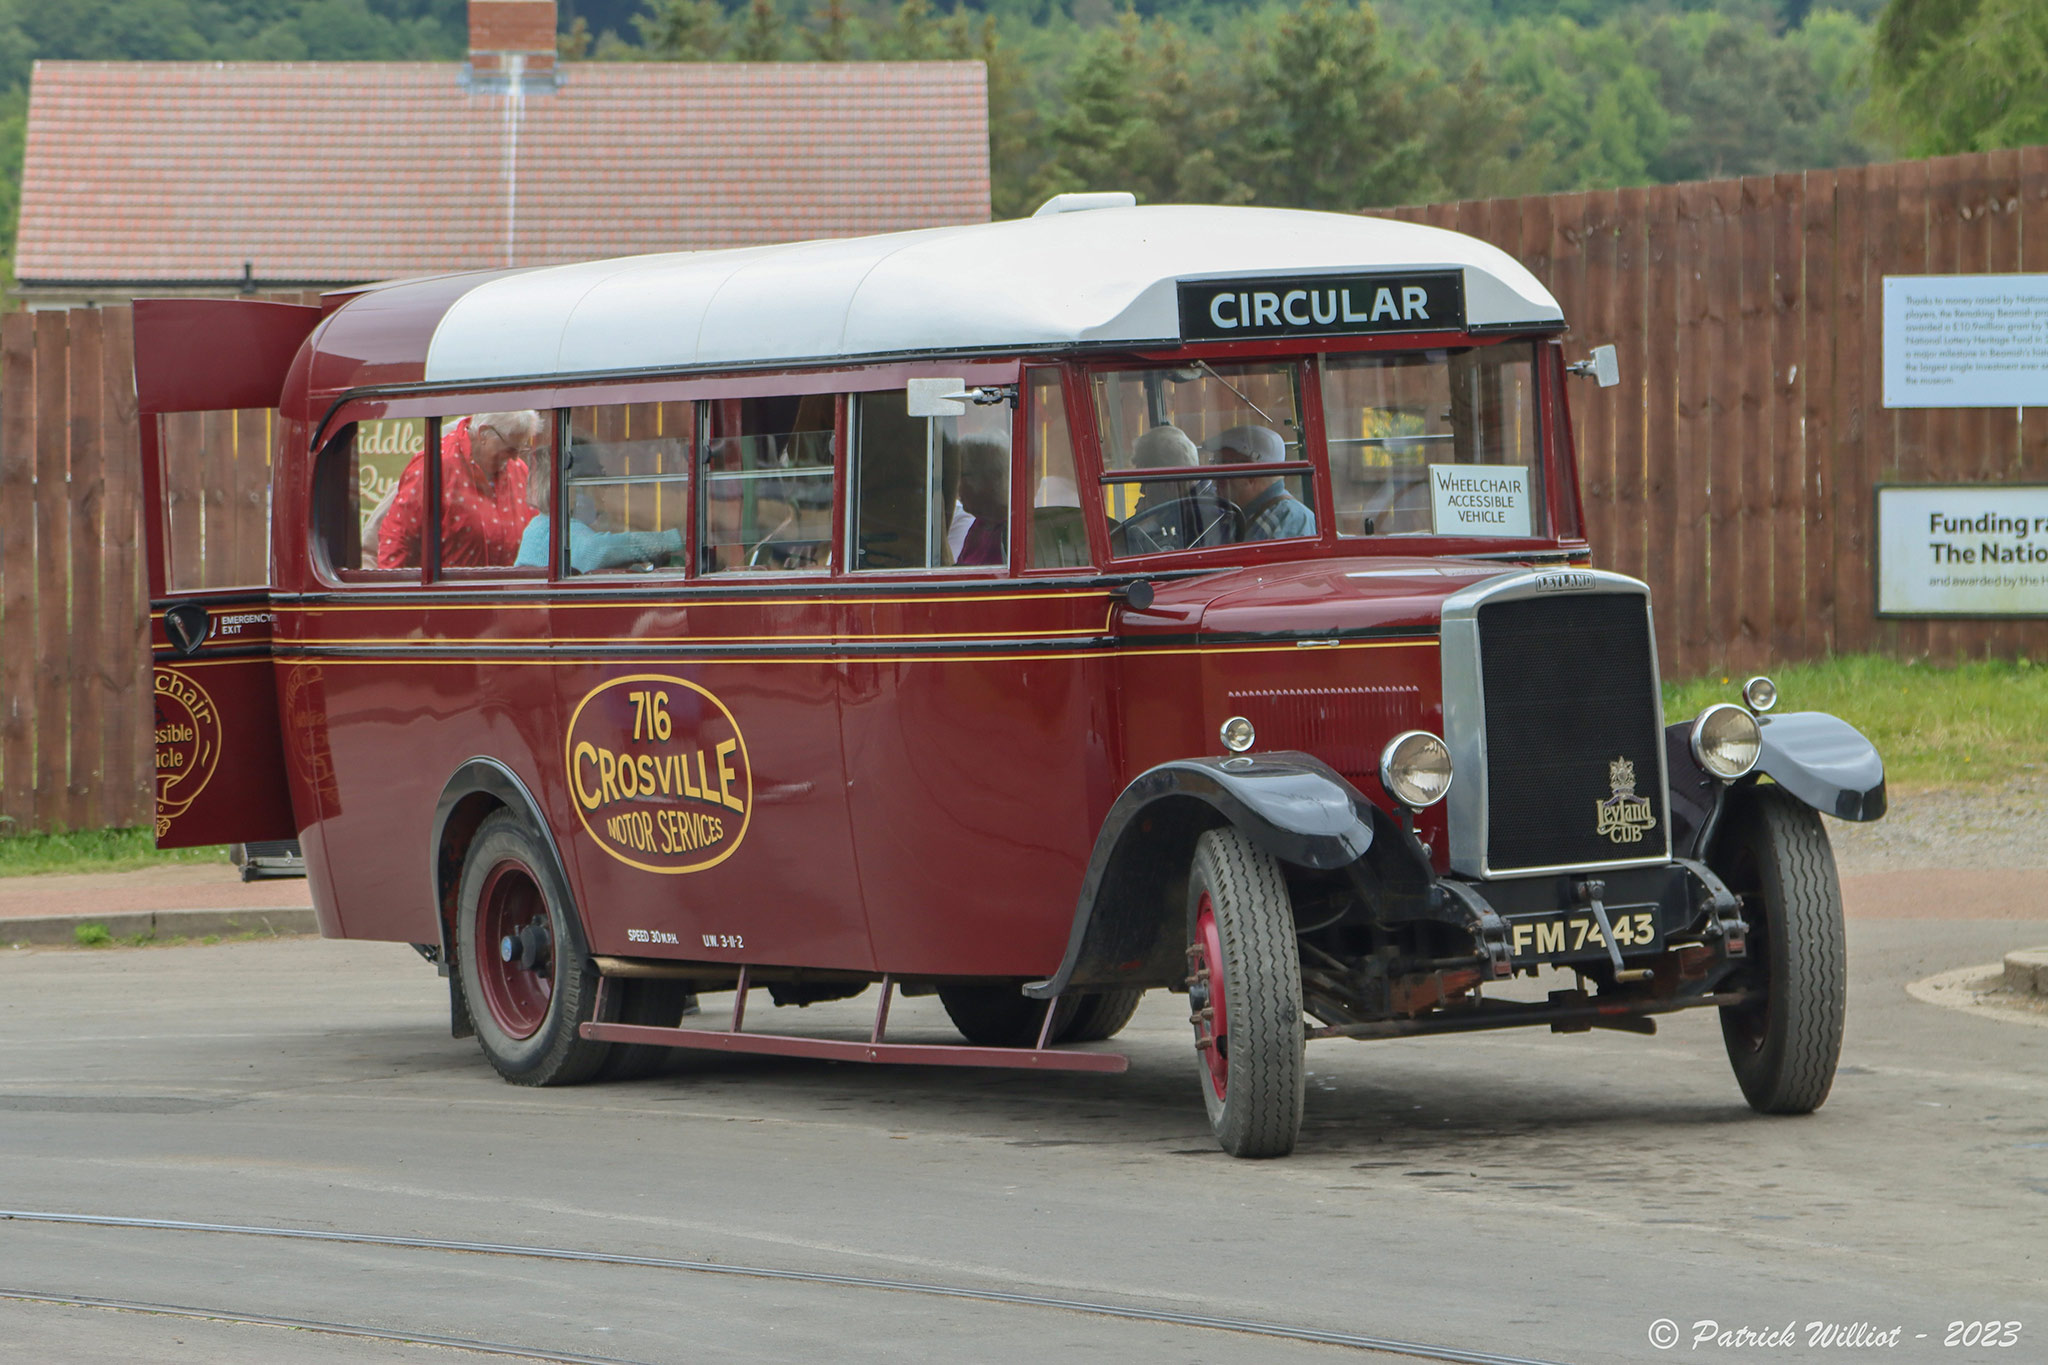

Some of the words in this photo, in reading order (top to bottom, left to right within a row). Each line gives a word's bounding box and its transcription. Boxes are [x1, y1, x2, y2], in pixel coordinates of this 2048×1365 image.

[1210, 286, 1430, 329] CIRCULAR
[1906, 296, 1932, 304] Thanks
[1945, 298, 1973, 306] money
[2004, 296, 2013, 305] by
[1998, 308, 2032, 317] Beamish
[1906, 323, 1942, 331] awarded
[2008, 324, 2029, 333] grant
[2032, 322, 2042, 332] by
[1906, 336, 1940, 345] National
[1945, 337, 1971, 346] Lottery
[1975, 336, 2009, 346] Heritage
[2013, 335, 2032, 344] Fund
[1906, 363, 1916, 371] the
[1920, 362, 1947, 373] largest
[1950, 362, 1973, 373] single
[1976, 362, 2017, 370] investment
[1906, 376, 1917, 384] the
[1437, 472, 1521, 493] WHEELCHAIR
[1448, 495, 1515, 508] ACCESSIBLE
[1458, 510, 1505, 523] VEHICLE
[1930, 513, 2028, 538] Funding
[2035, 516, 2048, 533] r
[1930, 543, 1976, 564] The
[1982, 543, 2048, 564] Natio
[1538, 574, 1592, 589] LEYLAND
[1929, 575, 1950, 587] and
[1952, 575, 2001, 587] awarded
[2004, 575, 2016, 589] by
[2020, 575, 2039, 587] the
[221, 614, 272, 624] EMERGENCY
[222, 625, 242, 634] EXIT
[154, 674, 212, 725] chair
[629, 691, 672, 741] 716
[155, 747, 183, 768] icle
[574, 738, 744, 814] CROSVILLE
[1596, 797, 1654, 830] Leyland
[606, 811, 658, 853] MOTOR
[657, 810, 724, 854] SERVICES
[1610, 825, 1643, 843] CUB
[628, 929, 649, 942] SPEED
[650, 931, 660, 943] 30
[1512, 921, 1566, 956] FM
[1570, 913, 1655, 950] 7443
